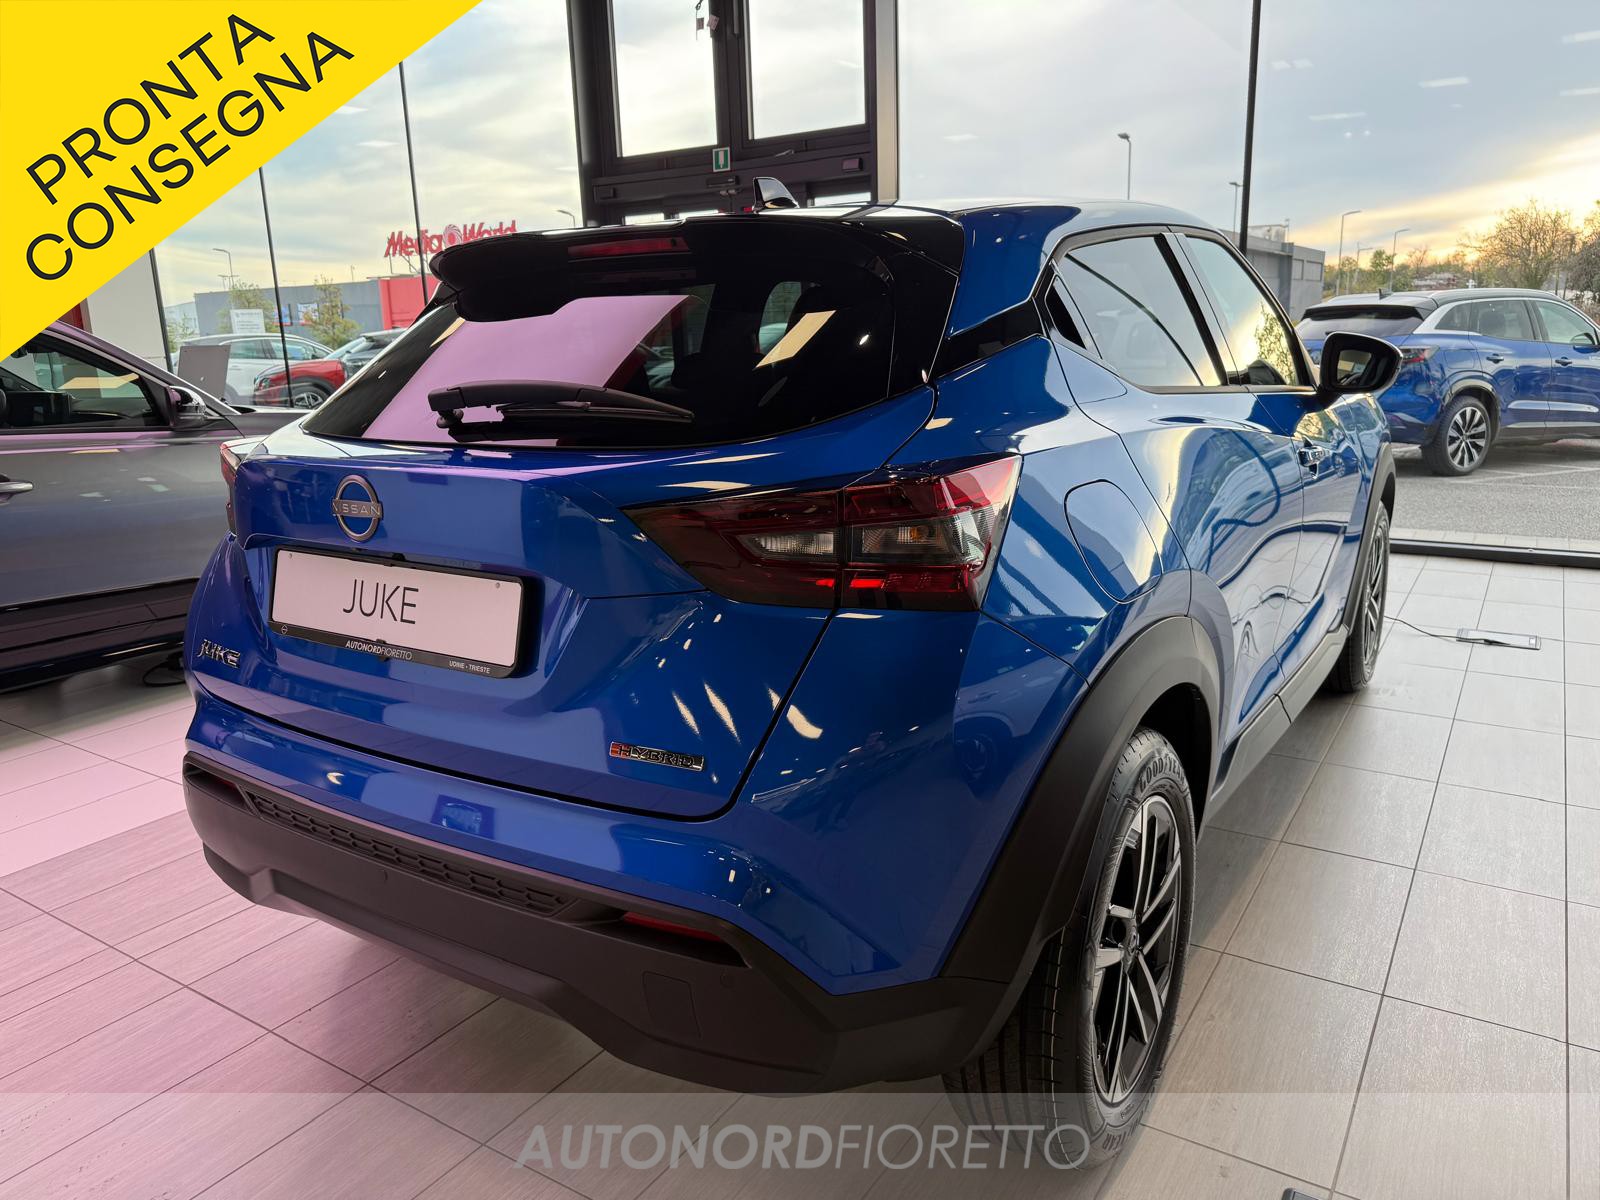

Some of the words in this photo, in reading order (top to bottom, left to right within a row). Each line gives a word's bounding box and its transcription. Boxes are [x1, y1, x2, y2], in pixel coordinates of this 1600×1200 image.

[343, 578, 420, 625] JUKE
[197, 638, 241, 669] JUKE
[345, 640, 413, 661] AUTONORDFIORETTO
[469, 663, 490, 674] TRIESTE
